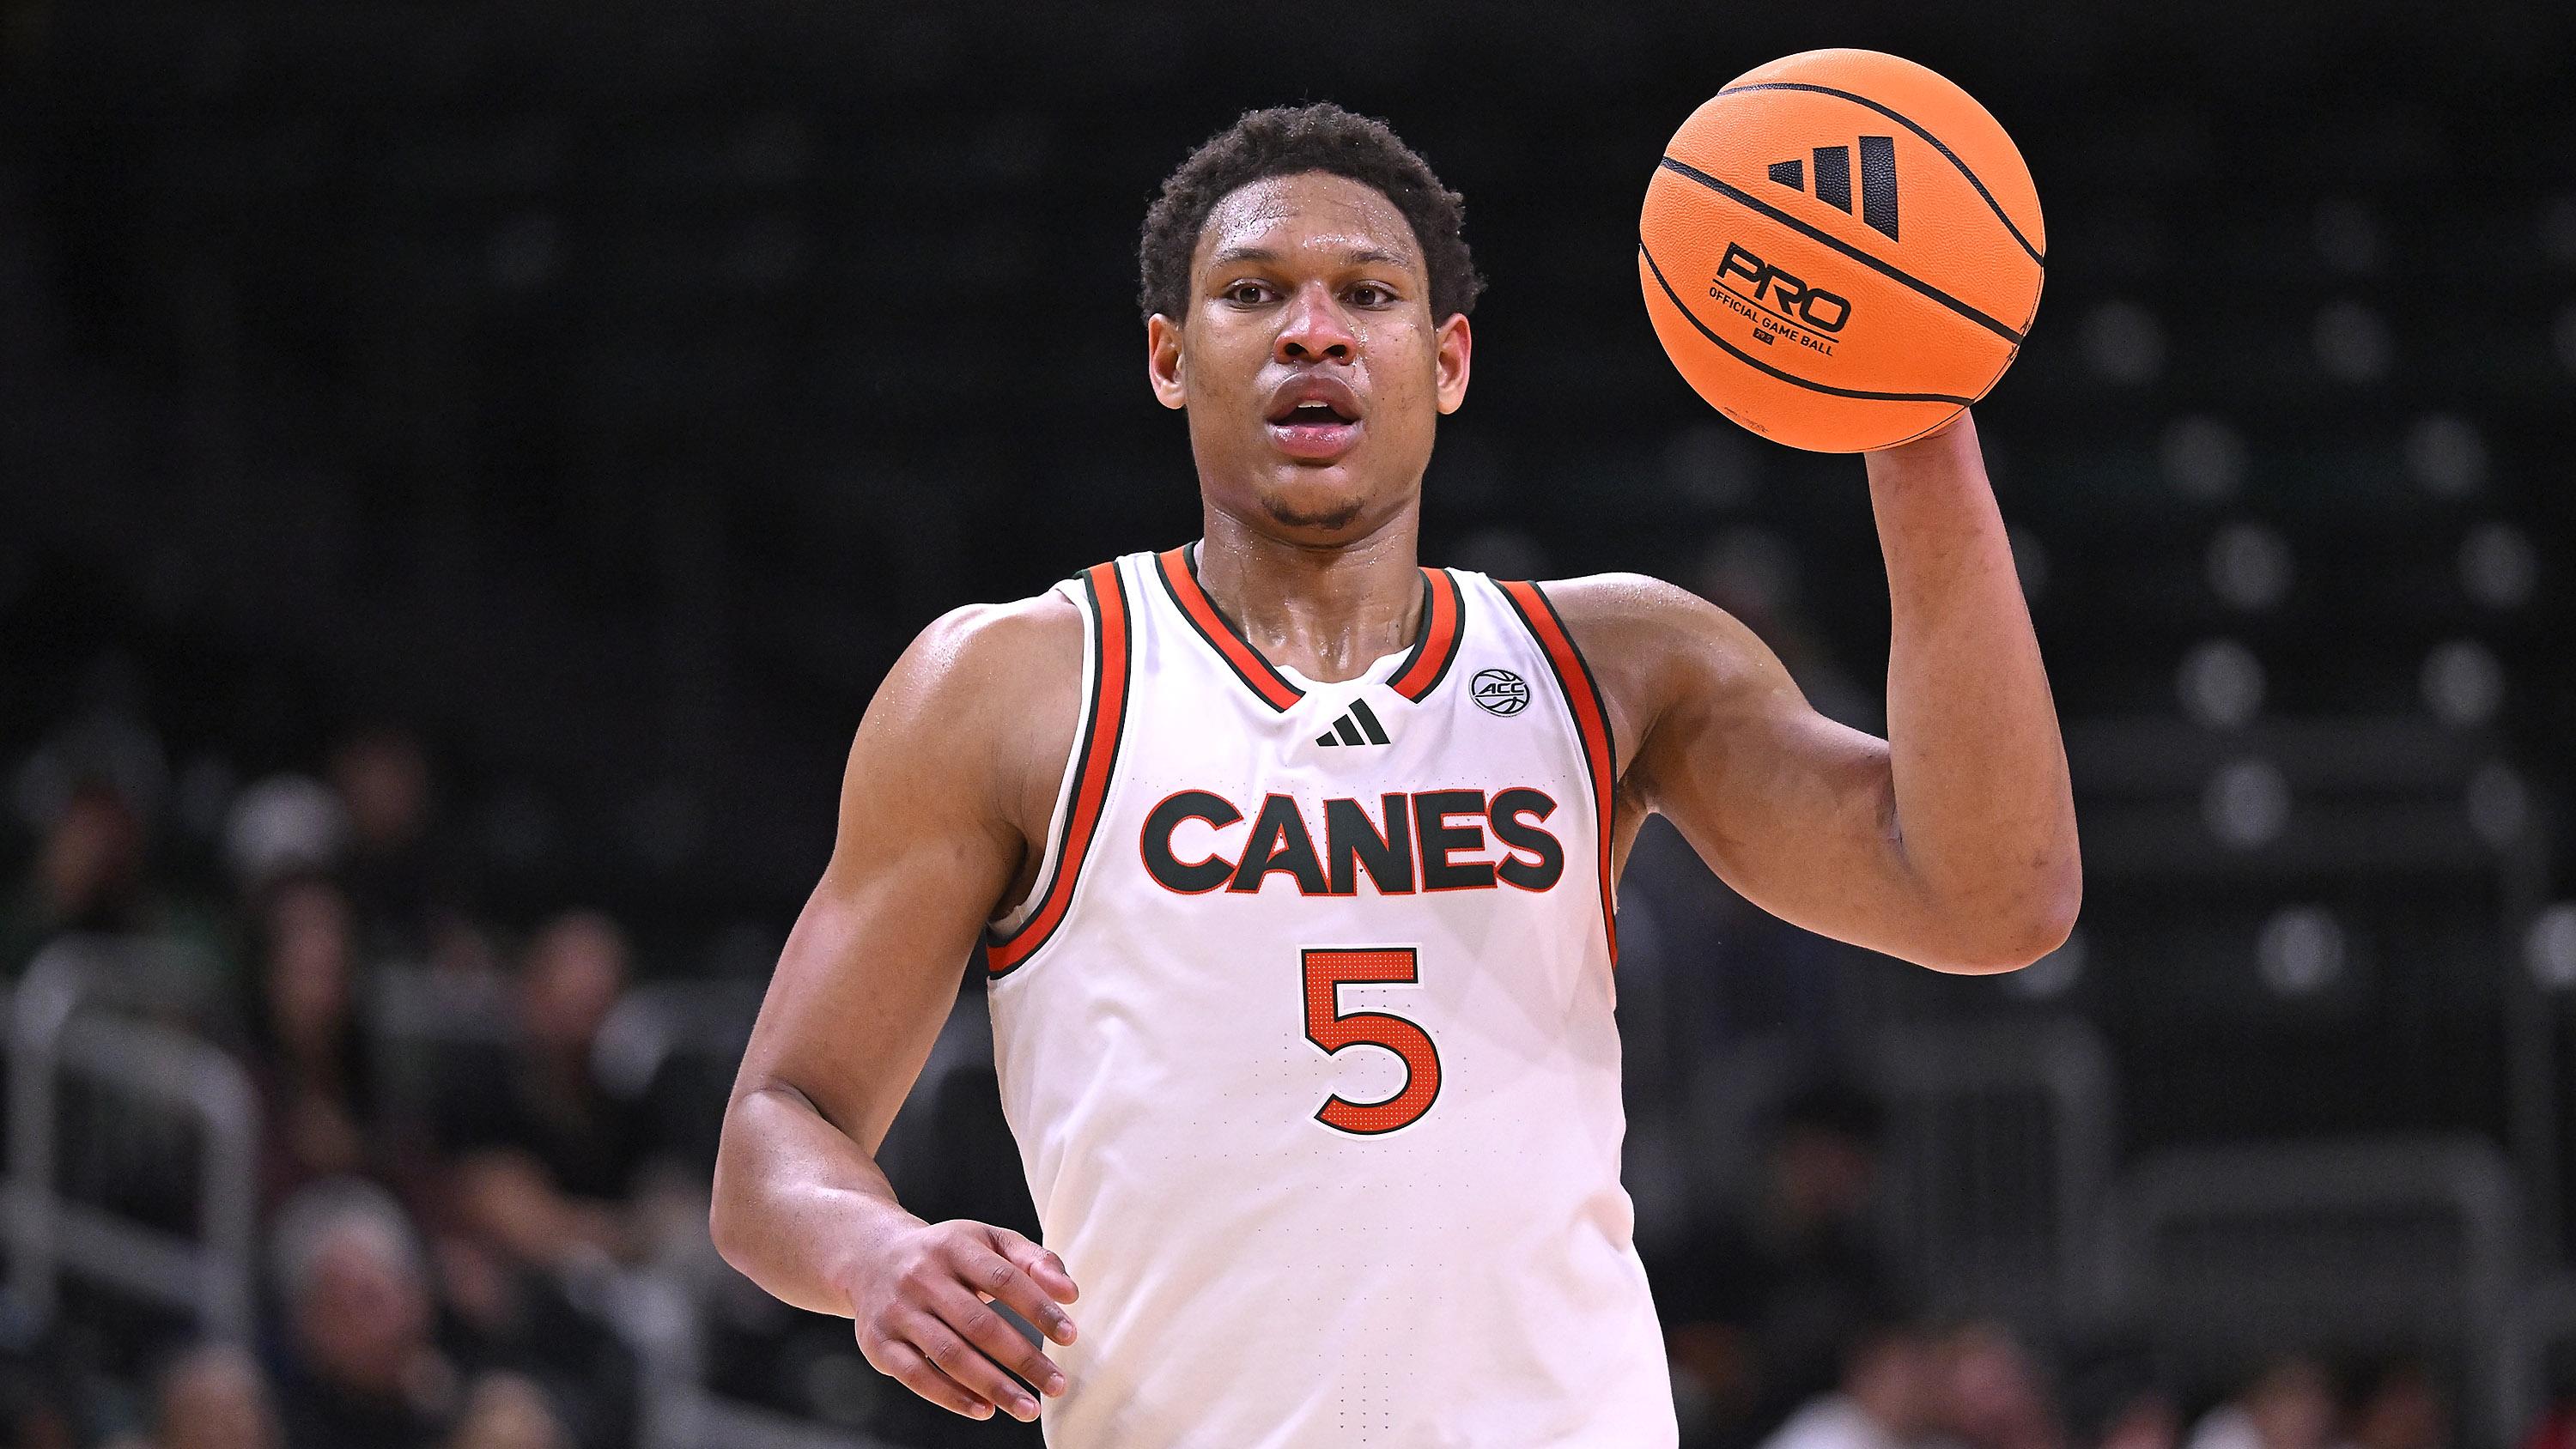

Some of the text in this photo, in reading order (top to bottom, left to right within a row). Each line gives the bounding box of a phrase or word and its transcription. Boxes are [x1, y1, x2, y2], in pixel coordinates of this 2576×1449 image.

[1709, 287, 1833, 357] OFFICIAL GAME BALL
[1716, 241, 1852, 333] PRO
[1478, 682, 1526, 694] ACC
[1139, 787, 1564, 896] CANES
[1300, 948, 1443, 1136] 5
